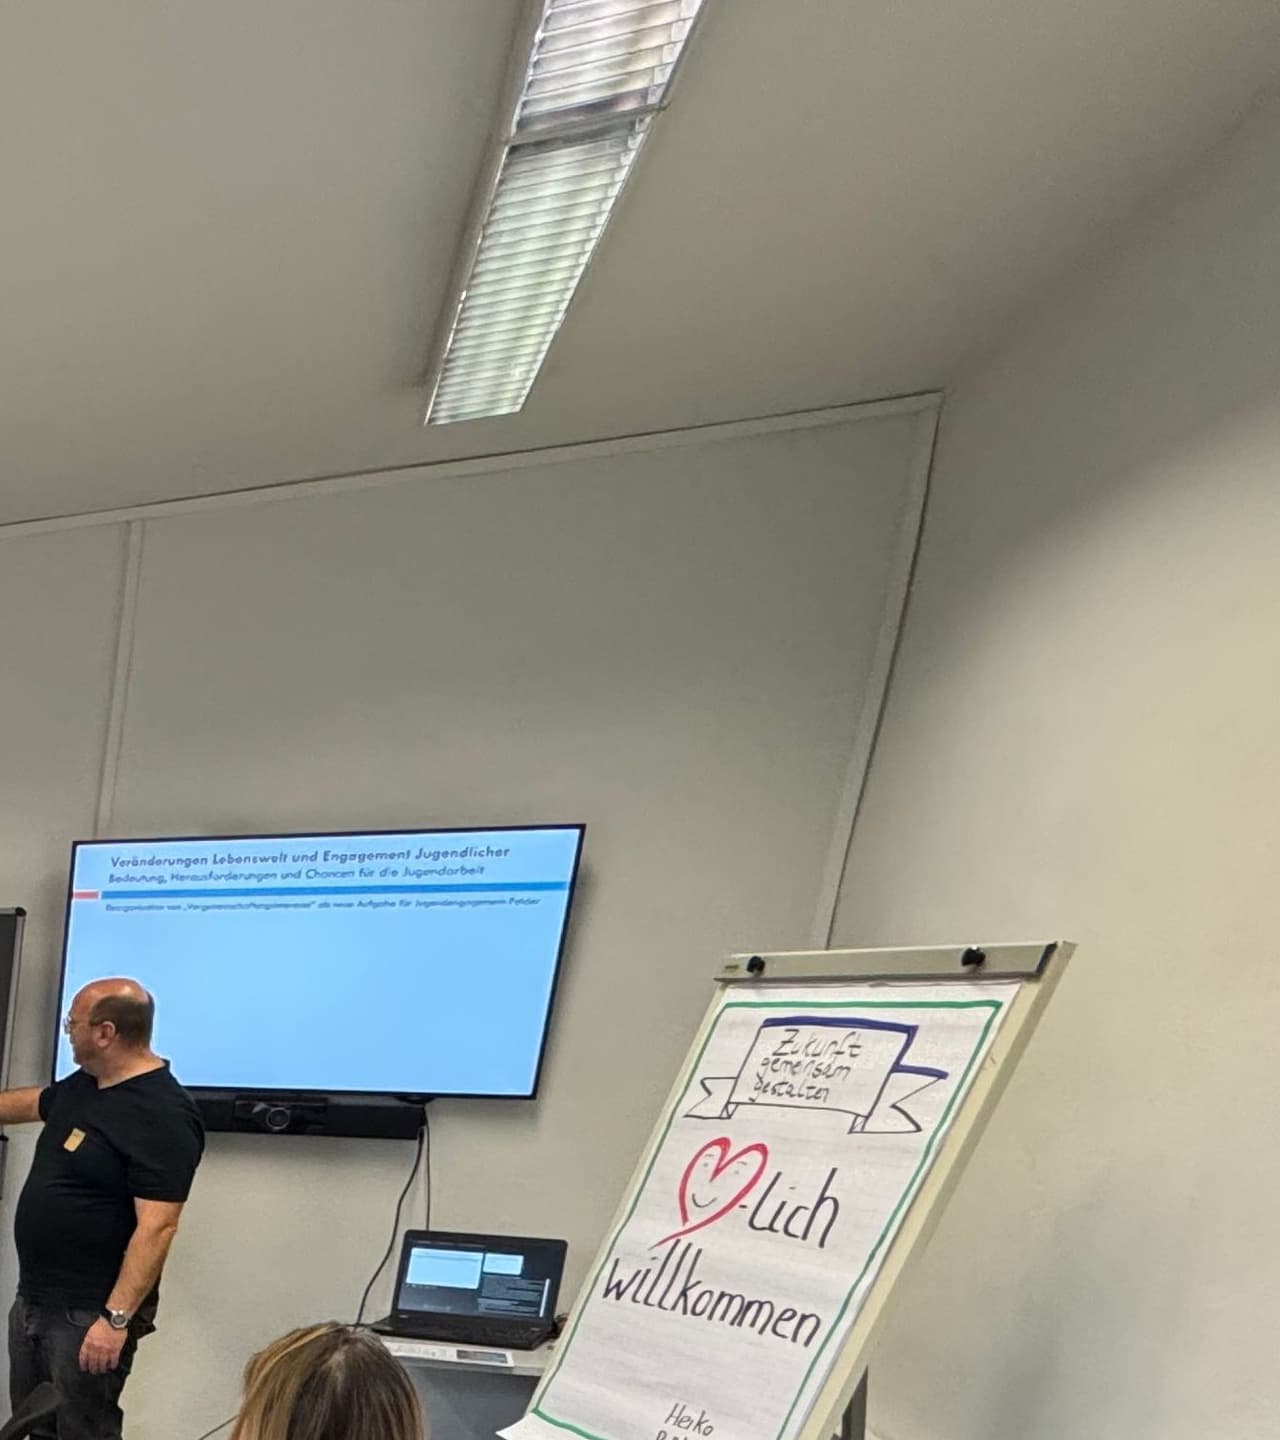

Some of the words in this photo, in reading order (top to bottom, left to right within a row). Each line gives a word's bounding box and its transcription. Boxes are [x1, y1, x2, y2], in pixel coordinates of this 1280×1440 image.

[111, 856, 208, 868] Veränderungen
[213, 853, 288, 865] Lebenswelt
[292, 851, 318, 863] und
[323, 849, 410, 864] Engagement
[415, 846, 510, 861] Jugendlicher
[171, 871, 277, 883] Herausforderungen
[281, 870, 302, 880] und
[306, 869, 354, 879] Chancen
[379, 867, 398, 877] die
[402, 866, 485, 879] Jugendarbeit
[772, 1028, 863, 1059] Zukunft
[748, 1078, 830, 1104] gestalten
[602, 1238, 822, 1348] willkommen
[663, 1402, 715, 1437] Heiko
